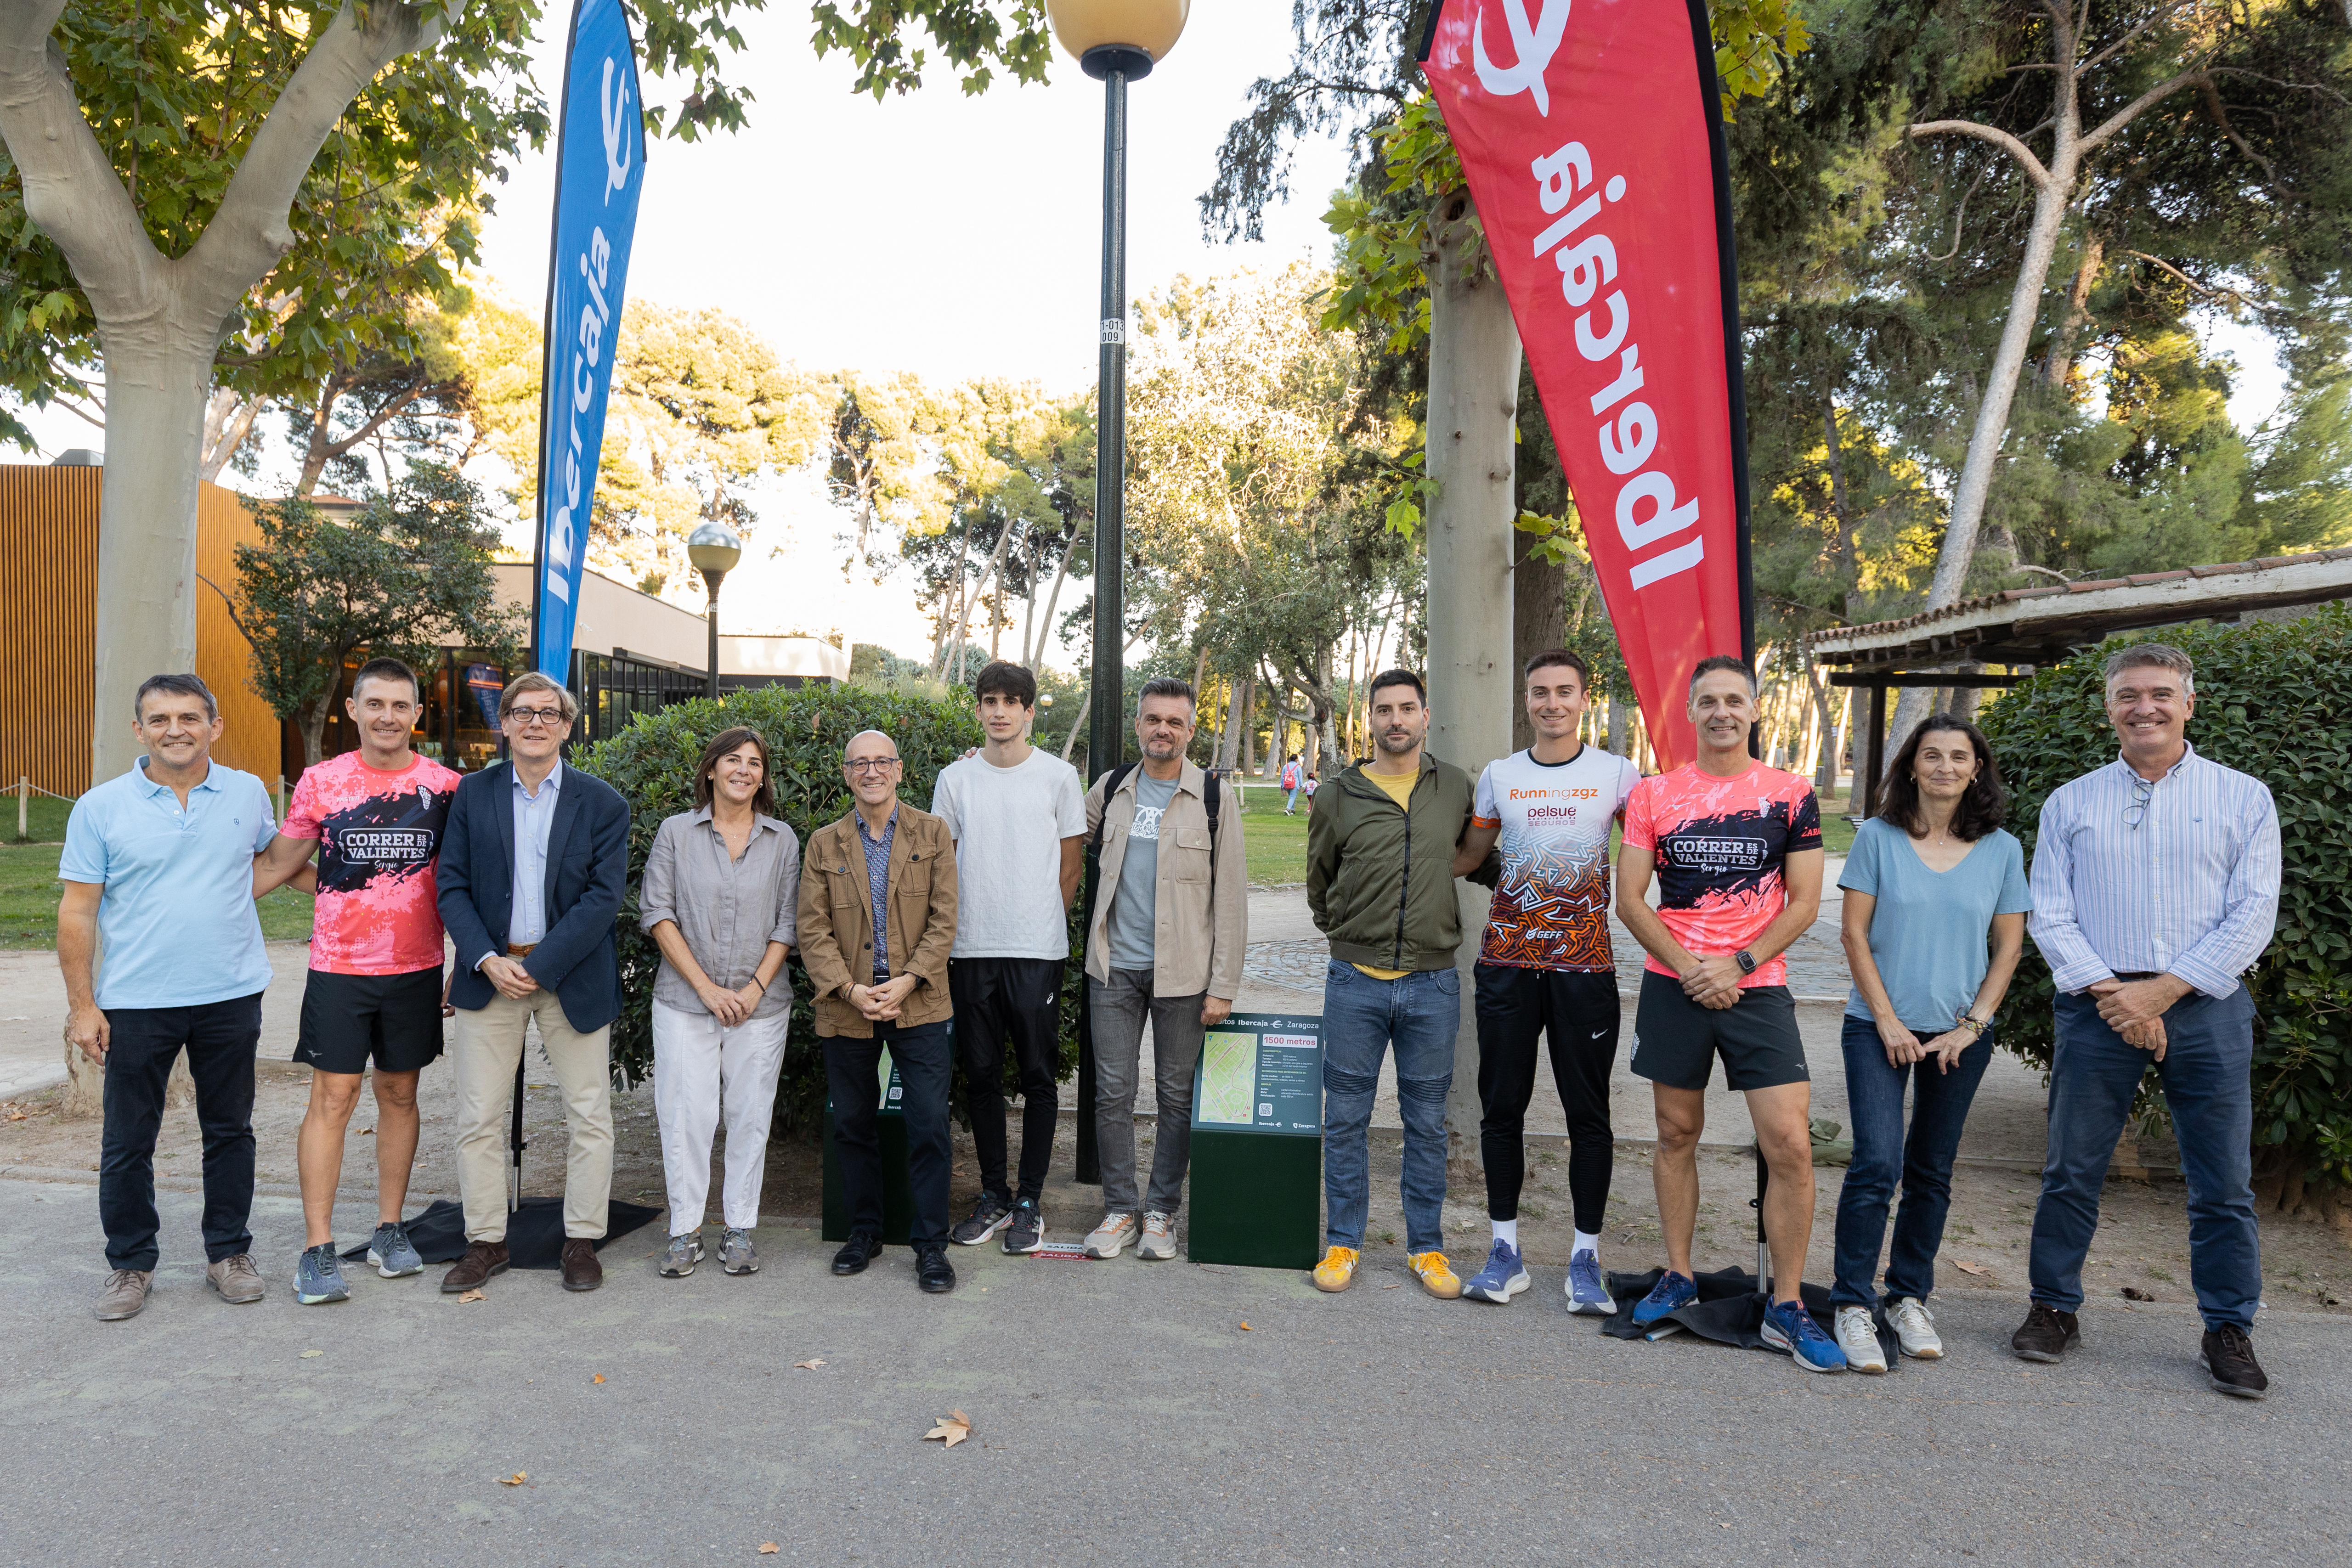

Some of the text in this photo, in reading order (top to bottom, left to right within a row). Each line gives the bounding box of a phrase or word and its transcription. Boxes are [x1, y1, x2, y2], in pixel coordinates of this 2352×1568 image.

[1101, 320, 1124, 331] 1-013
[1102, 332, 1118, 342] 009
[547, 226, 611, 604] Ibercaja
[1510, 787, 1598, 801] Runningzgz
[346, 834, 414, 846] CORRER
[347, 847, 425, 859] VALIENTES
[1674, 841, 1744, 854] CORRER
[1675, 854, 1757, 865] VALIENTES
[374, 860, 399, 872] Sergio
[1700, 863, 1729, 876] Sergio
[1287, 1021, 1319, 1030] Zaragoza
